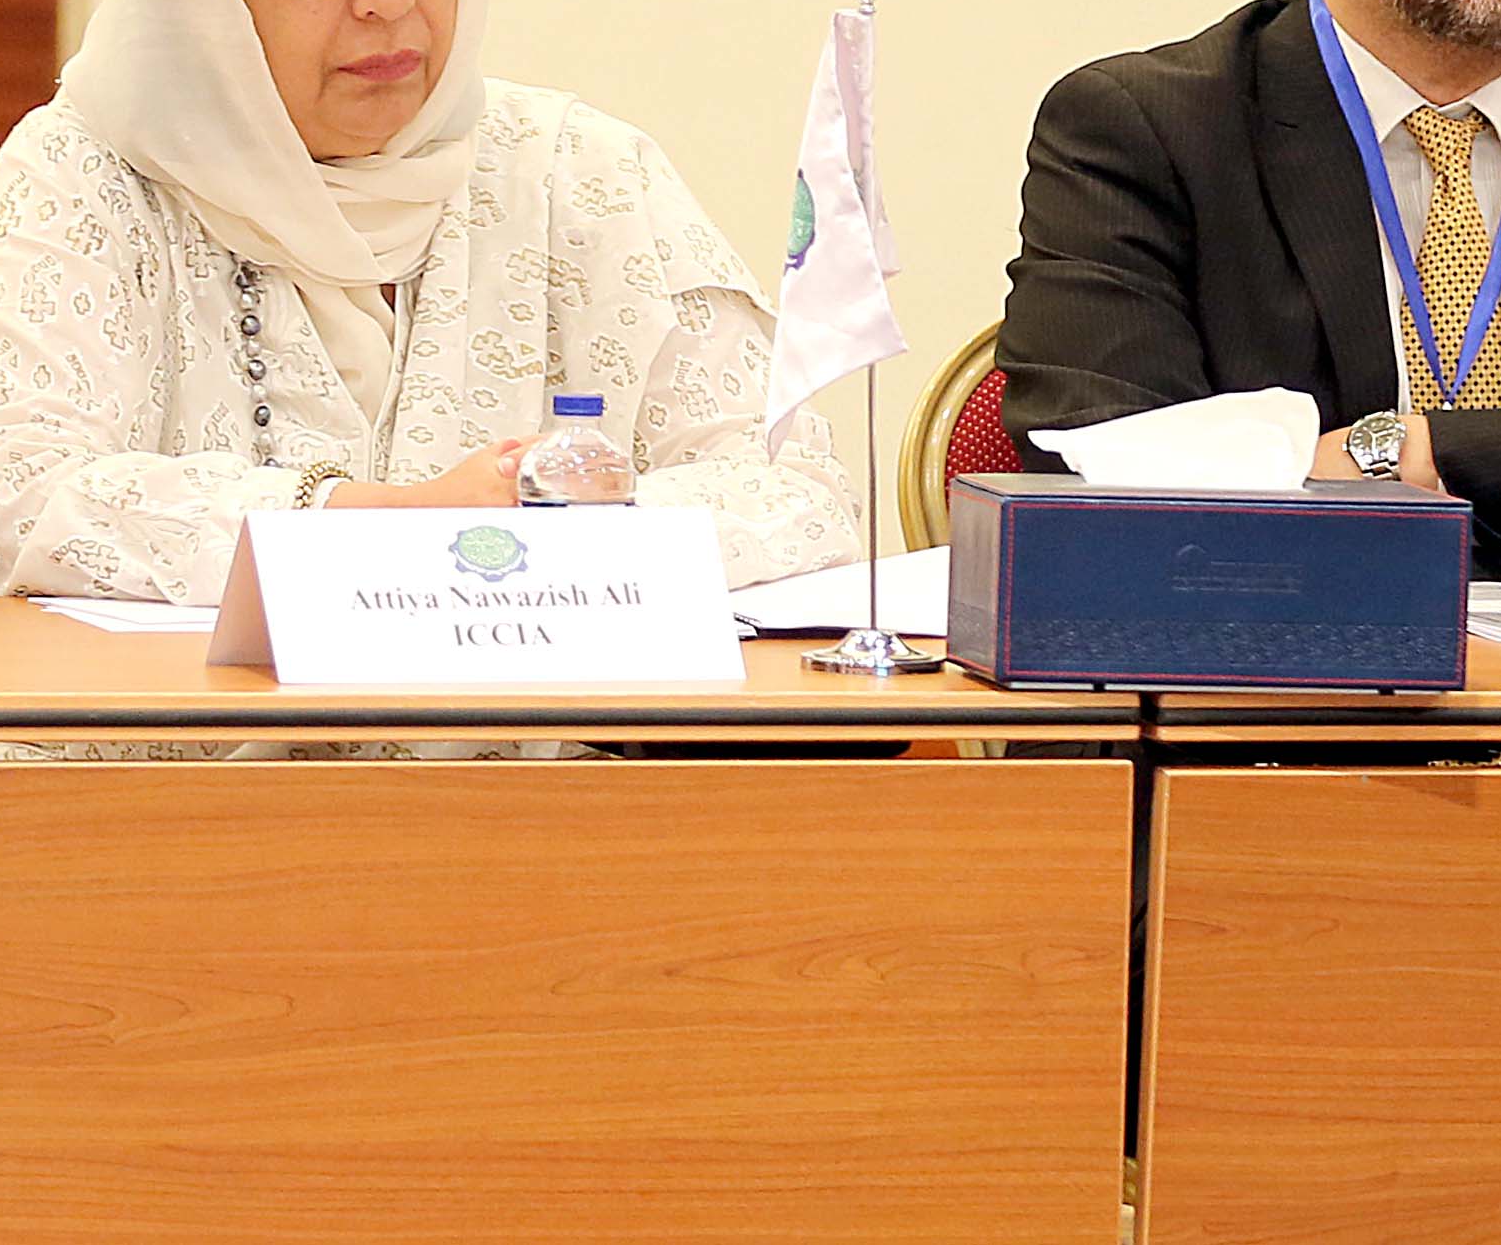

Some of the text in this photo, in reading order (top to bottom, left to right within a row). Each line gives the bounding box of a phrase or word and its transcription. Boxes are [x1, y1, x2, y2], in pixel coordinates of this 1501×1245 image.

[352, 582, 641, 616] Attiya Nawazish Ali
[454, 623, 551, 646] ICCIA
